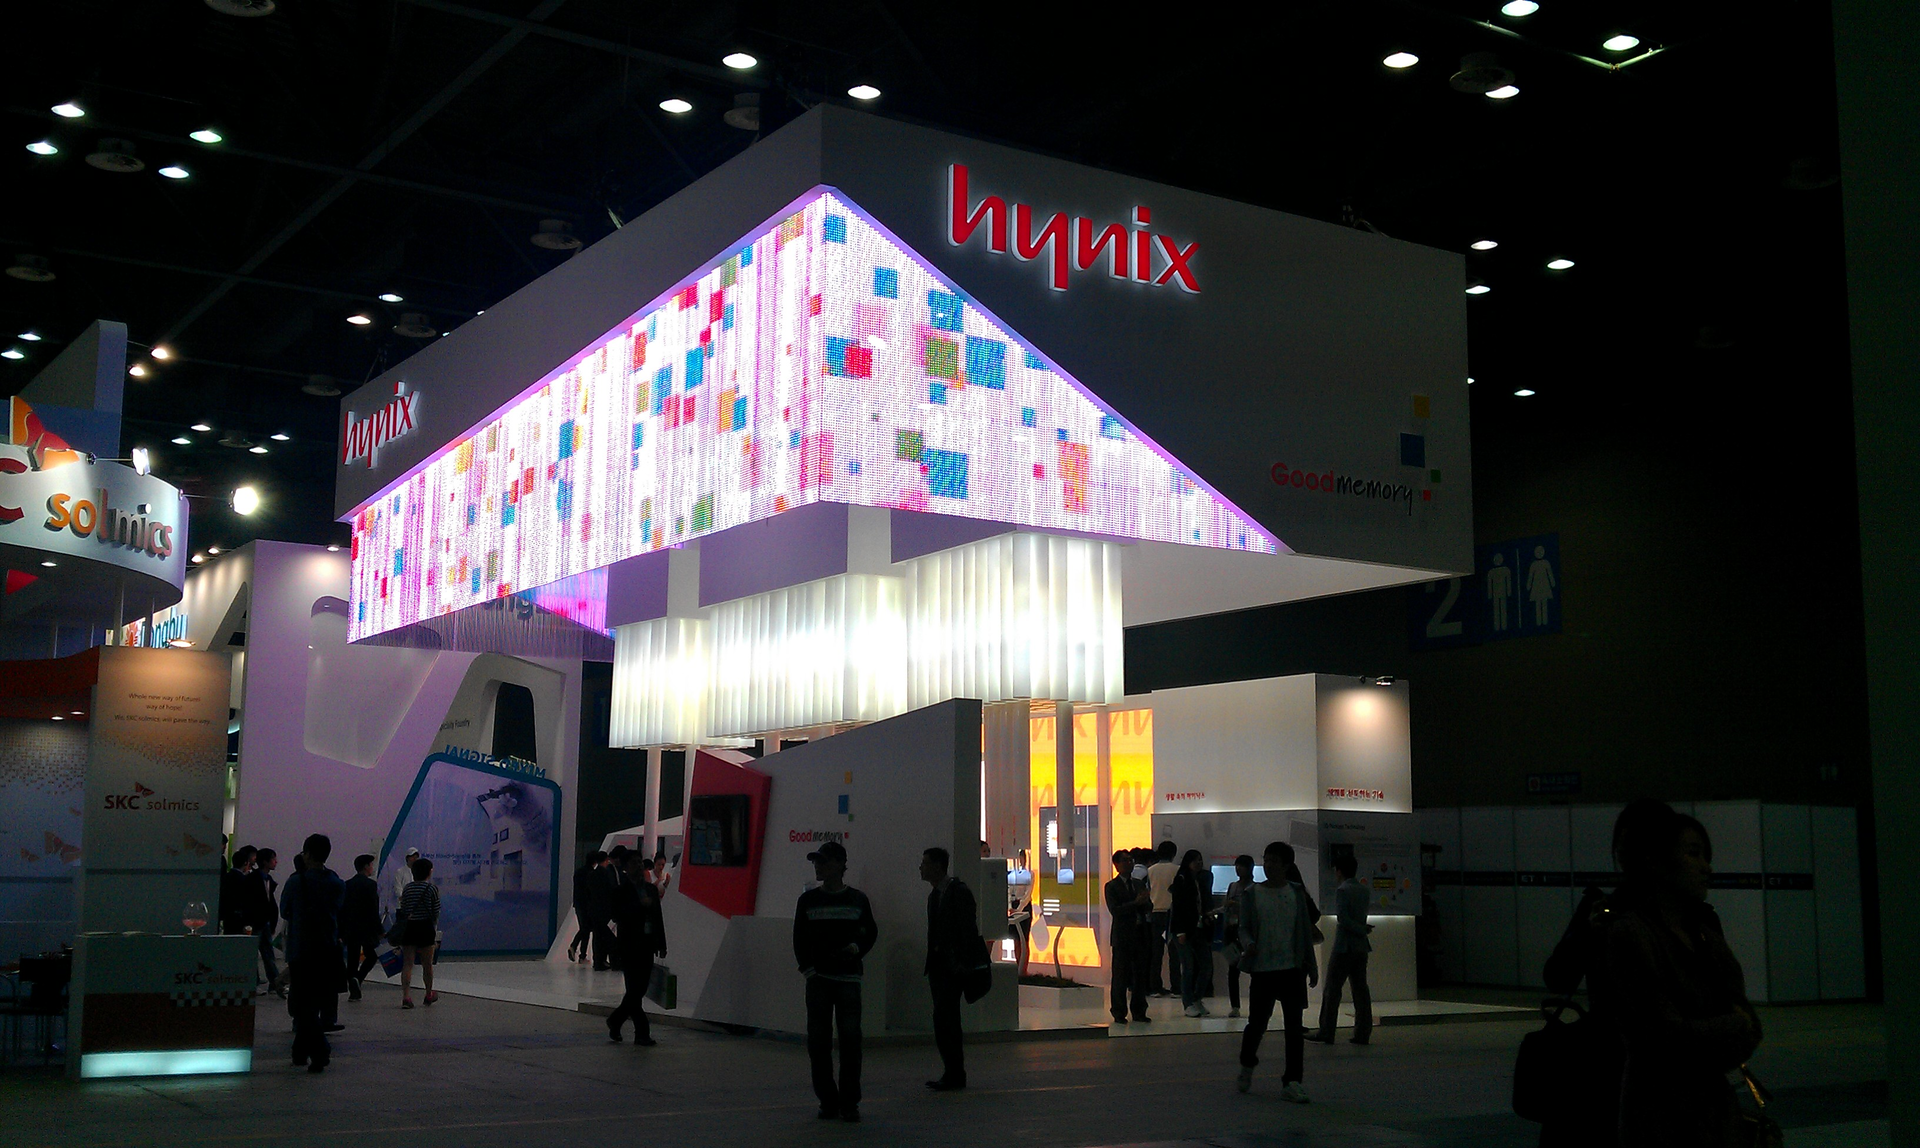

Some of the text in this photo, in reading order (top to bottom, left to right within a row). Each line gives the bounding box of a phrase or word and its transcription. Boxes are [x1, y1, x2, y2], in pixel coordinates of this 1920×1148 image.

[947, 164, 1201, 294] hynix
[342, 381, 420, 469] hynix
[43, 488, 173, 561] solmics
[104, 795, 199, 811] SKC solmics
[174, 972, 249, 985] SKC solmics
